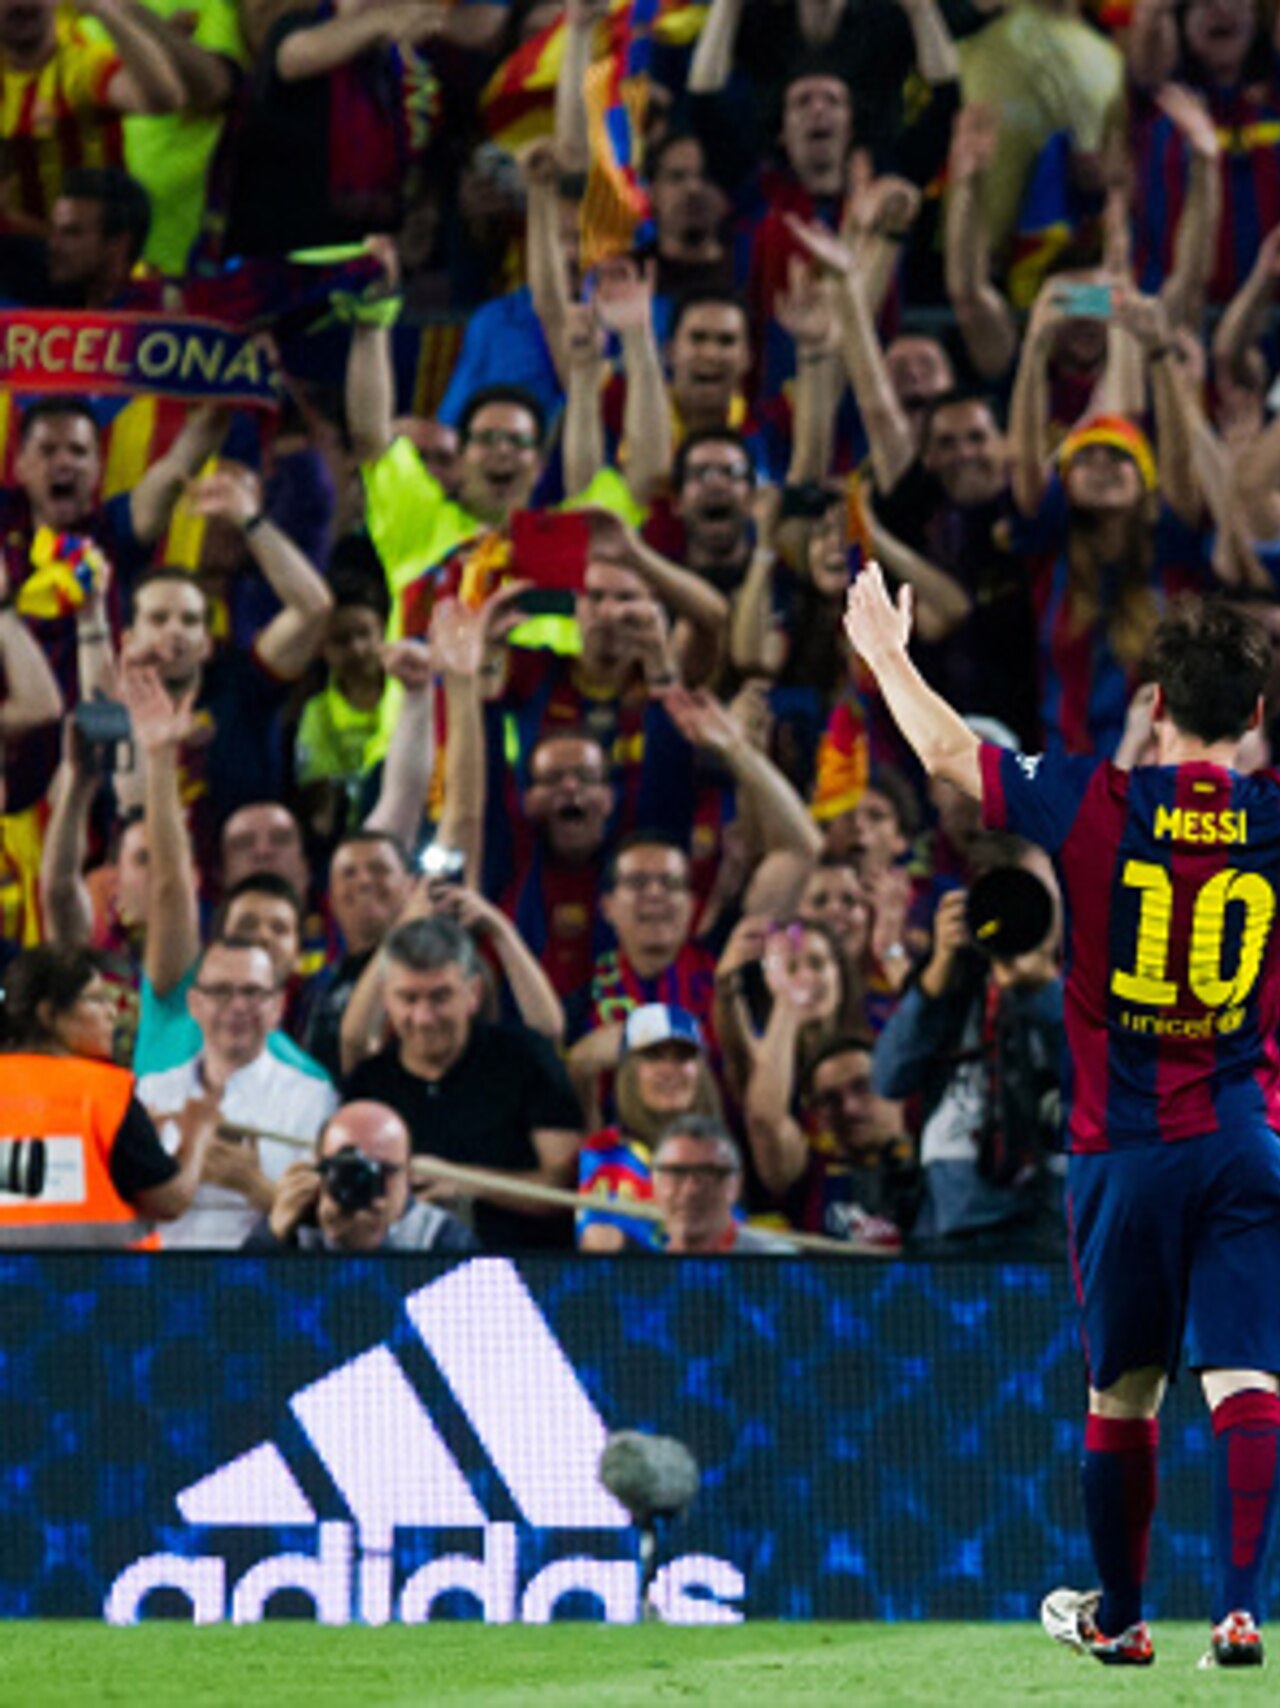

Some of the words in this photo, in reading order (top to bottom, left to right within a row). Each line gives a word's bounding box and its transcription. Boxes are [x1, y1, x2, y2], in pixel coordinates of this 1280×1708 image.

[0, 323, 261, 384] RCELONA
[1153, 804, 1248, 844] MESSI
[1111, 859, 1276, 1006] 10
[105, 1521, 744, 1625] adidas
